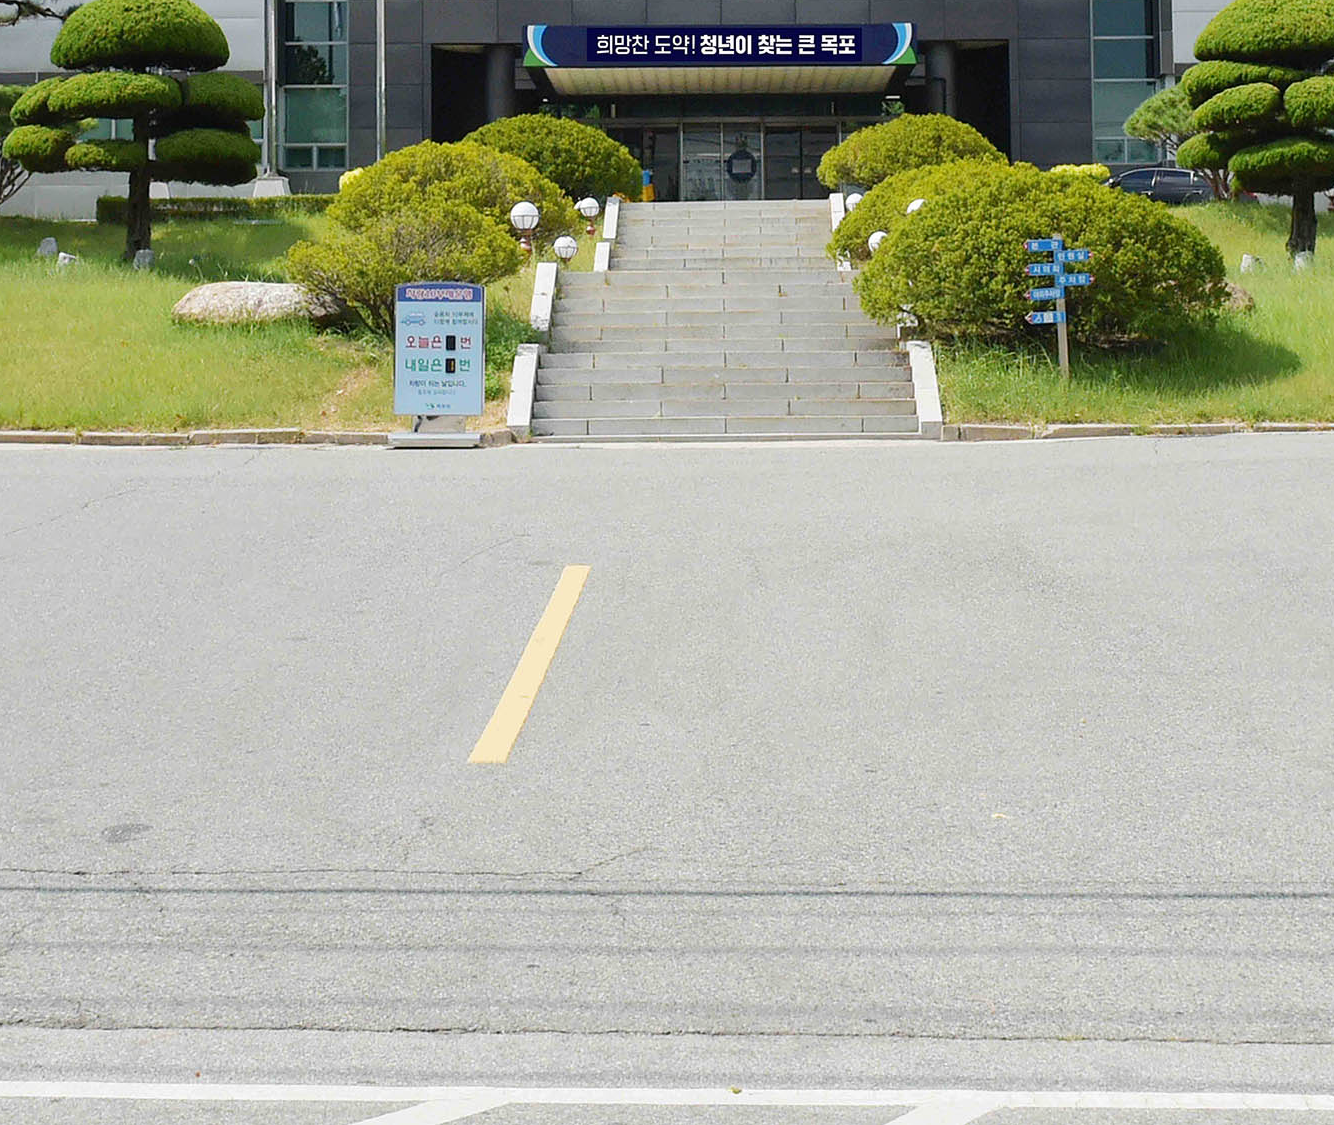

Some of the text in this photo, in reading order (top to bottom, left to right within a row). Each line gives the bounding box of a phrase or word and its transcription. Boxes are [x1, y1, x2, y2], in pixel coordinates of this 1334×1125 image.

[596, 34, 856, 55] 희망찬 도약! 청년이 찾는 큰 목포
[405, 335, 472, 349] 오늘은 번
[405, 358, 442, 372] 내일은
[459, 358, 471, 372] 번
